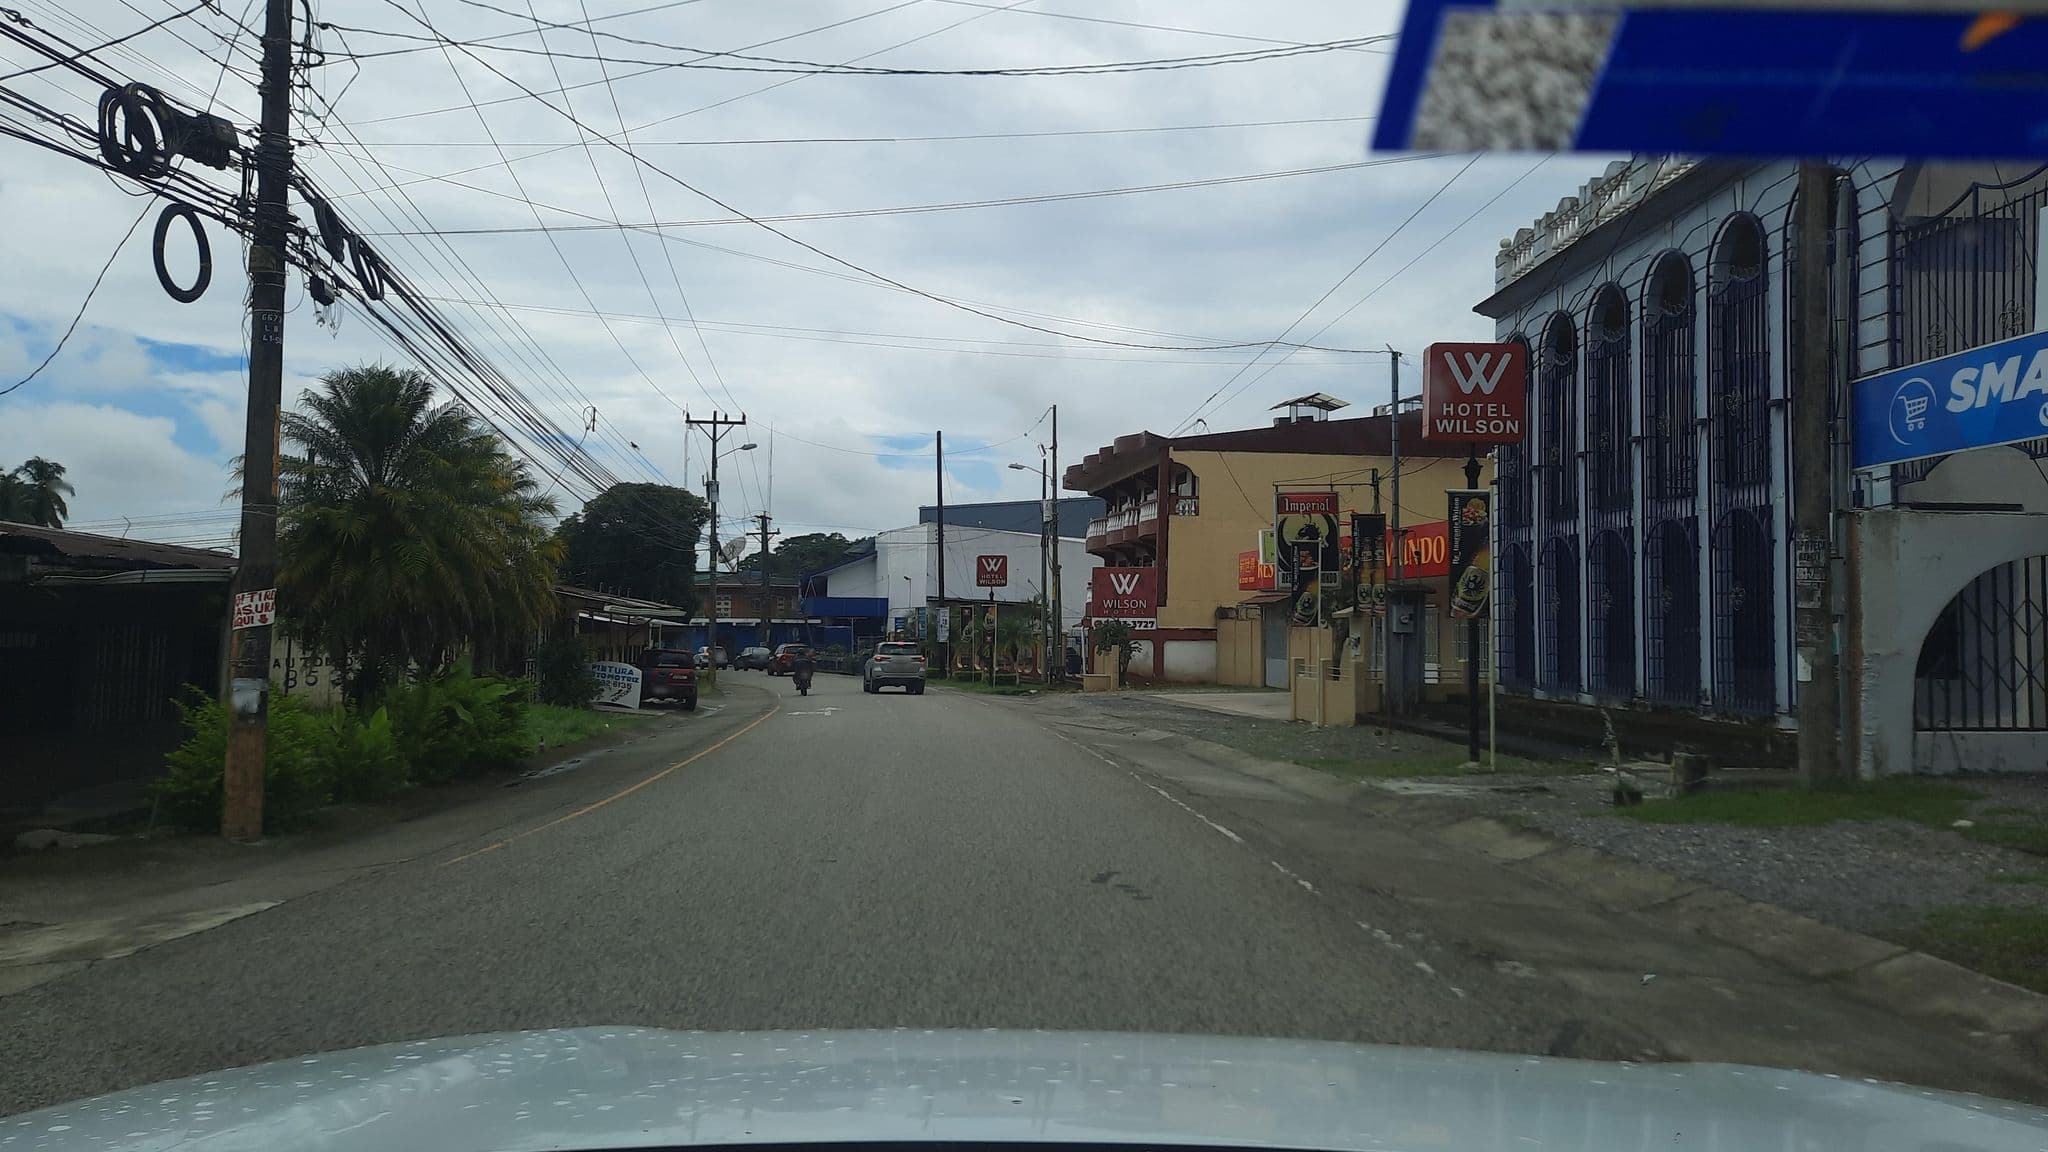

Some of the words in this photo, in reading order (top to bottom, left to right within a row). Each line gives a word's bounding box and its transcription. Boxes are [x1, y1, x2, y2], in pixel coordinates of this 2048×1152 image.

[1945, 348, 2048, 413] SMA
[1443, 403, 1512, 417] HOTEL
[1436, 420, 1519, 434] WILSON
[1285, 498, 1330, 515] Imperial
[1257, 562, 1274, 579] RES
[1103, 600, 1146, 608] WILSON
